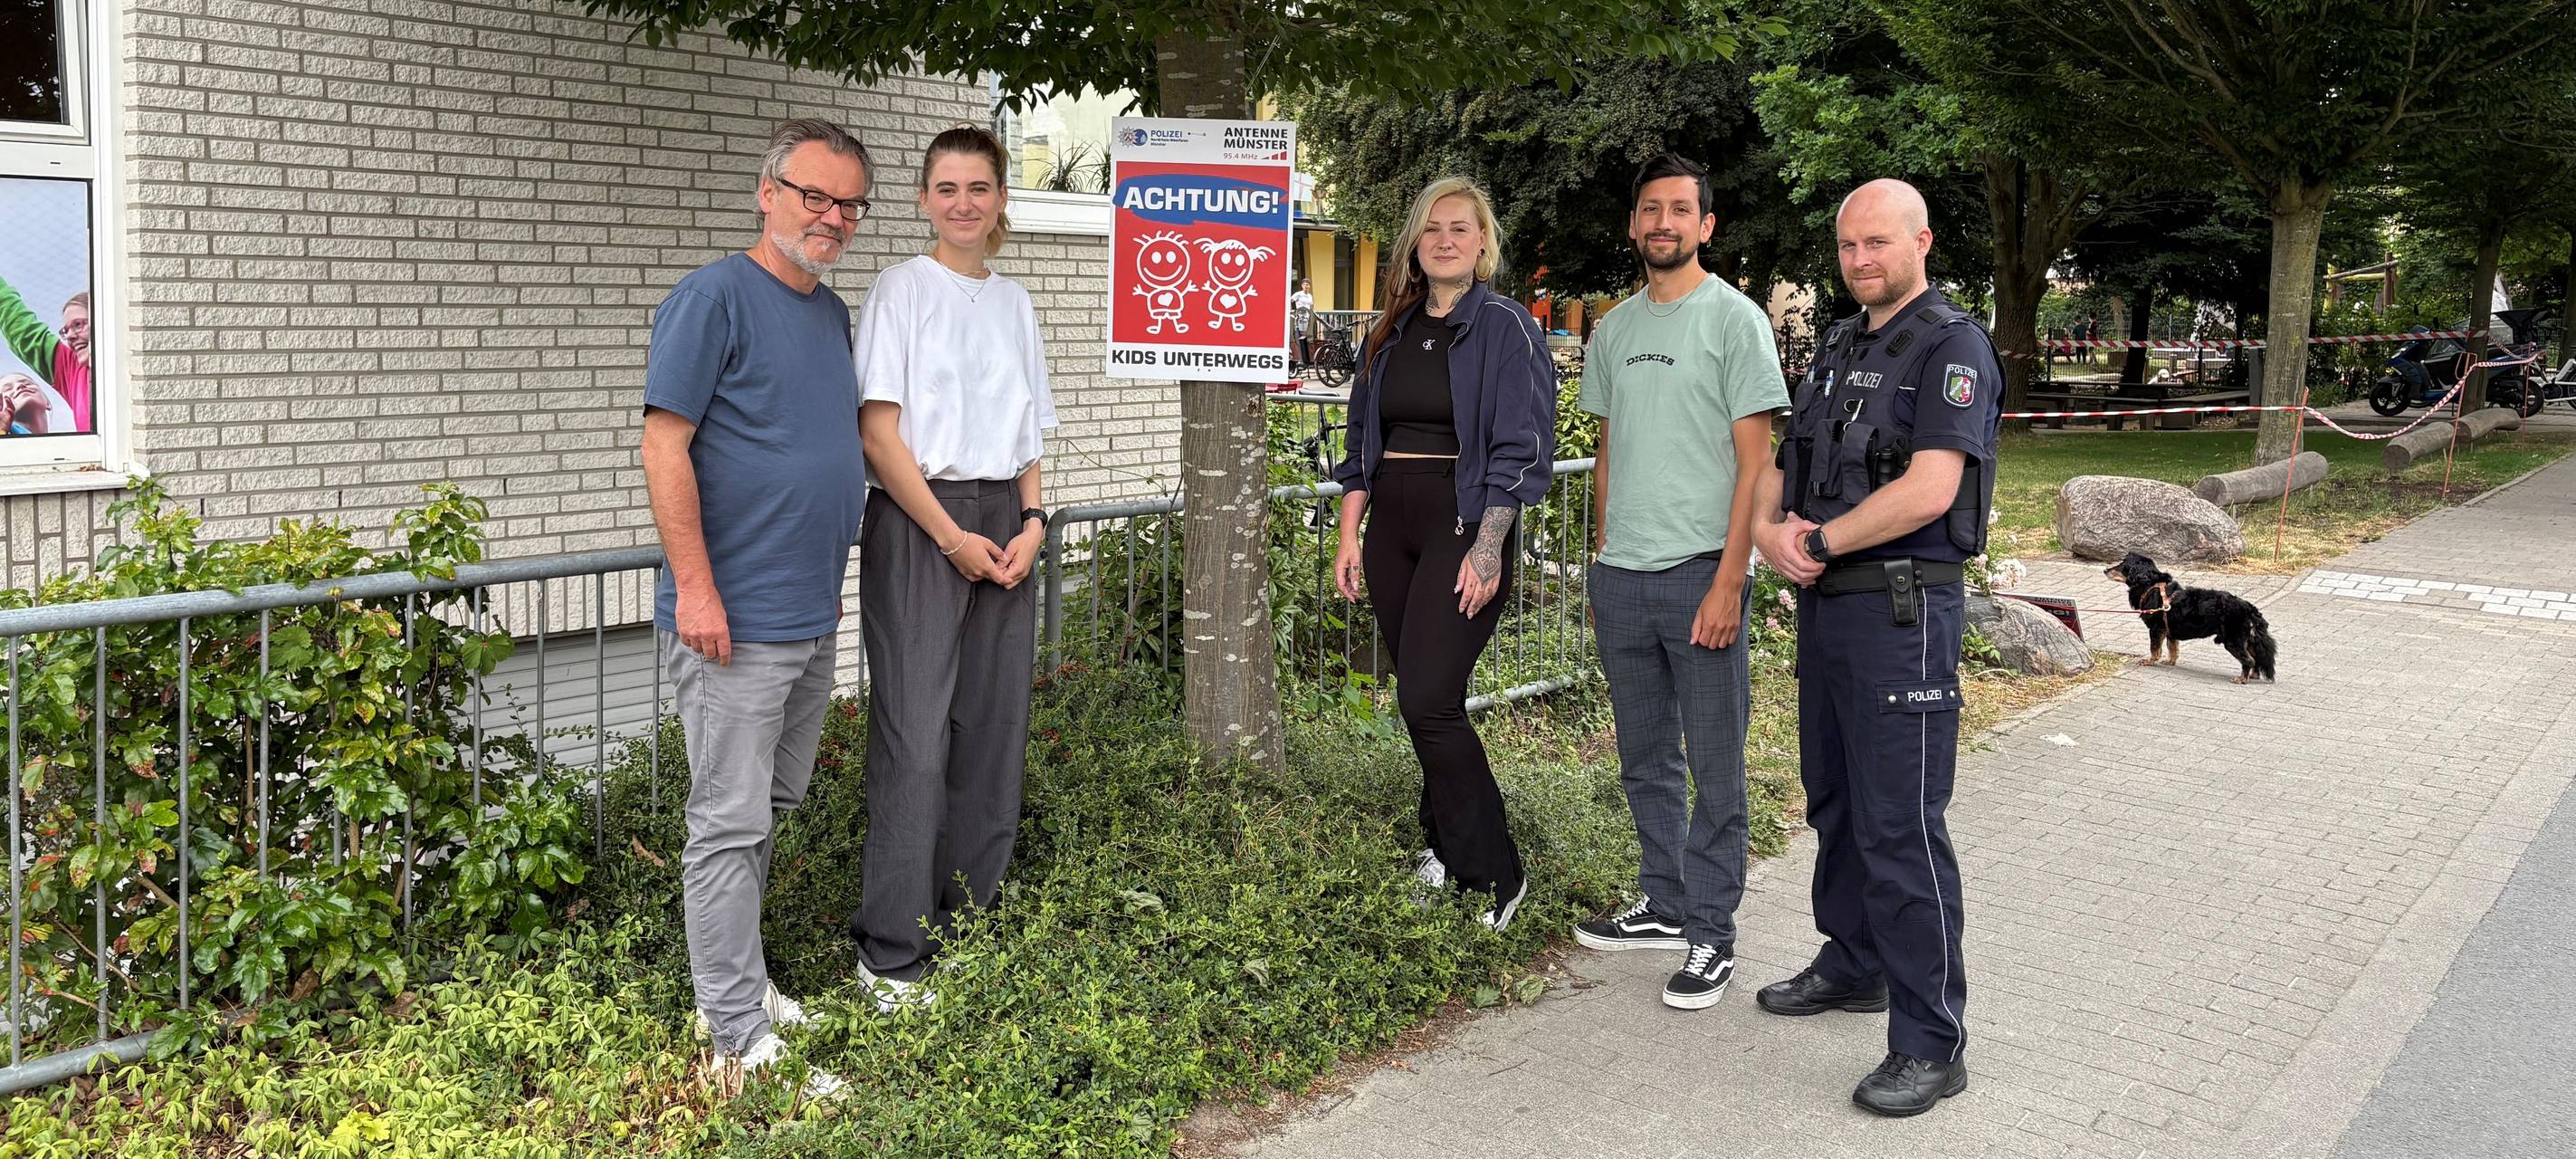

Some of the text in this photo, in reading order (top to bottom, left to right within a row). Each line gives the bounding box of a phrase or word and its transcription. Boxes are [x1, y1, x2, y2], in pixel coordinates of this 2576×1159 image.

[1224, 128, 1288, 139] ANTENNE
[1224, 138, 1288, 149] MÜNSTER
[1122, 187, 1279, 214] ACHTUNG!
[1111, 350, 1283, 369] KIDS UNTERWEGS
[1626, 353, 1674, 367] DICKIES
[1846, 370, 1883, 388] POLIZEI
[1907, 689, 1942, 703] POLIZEI
